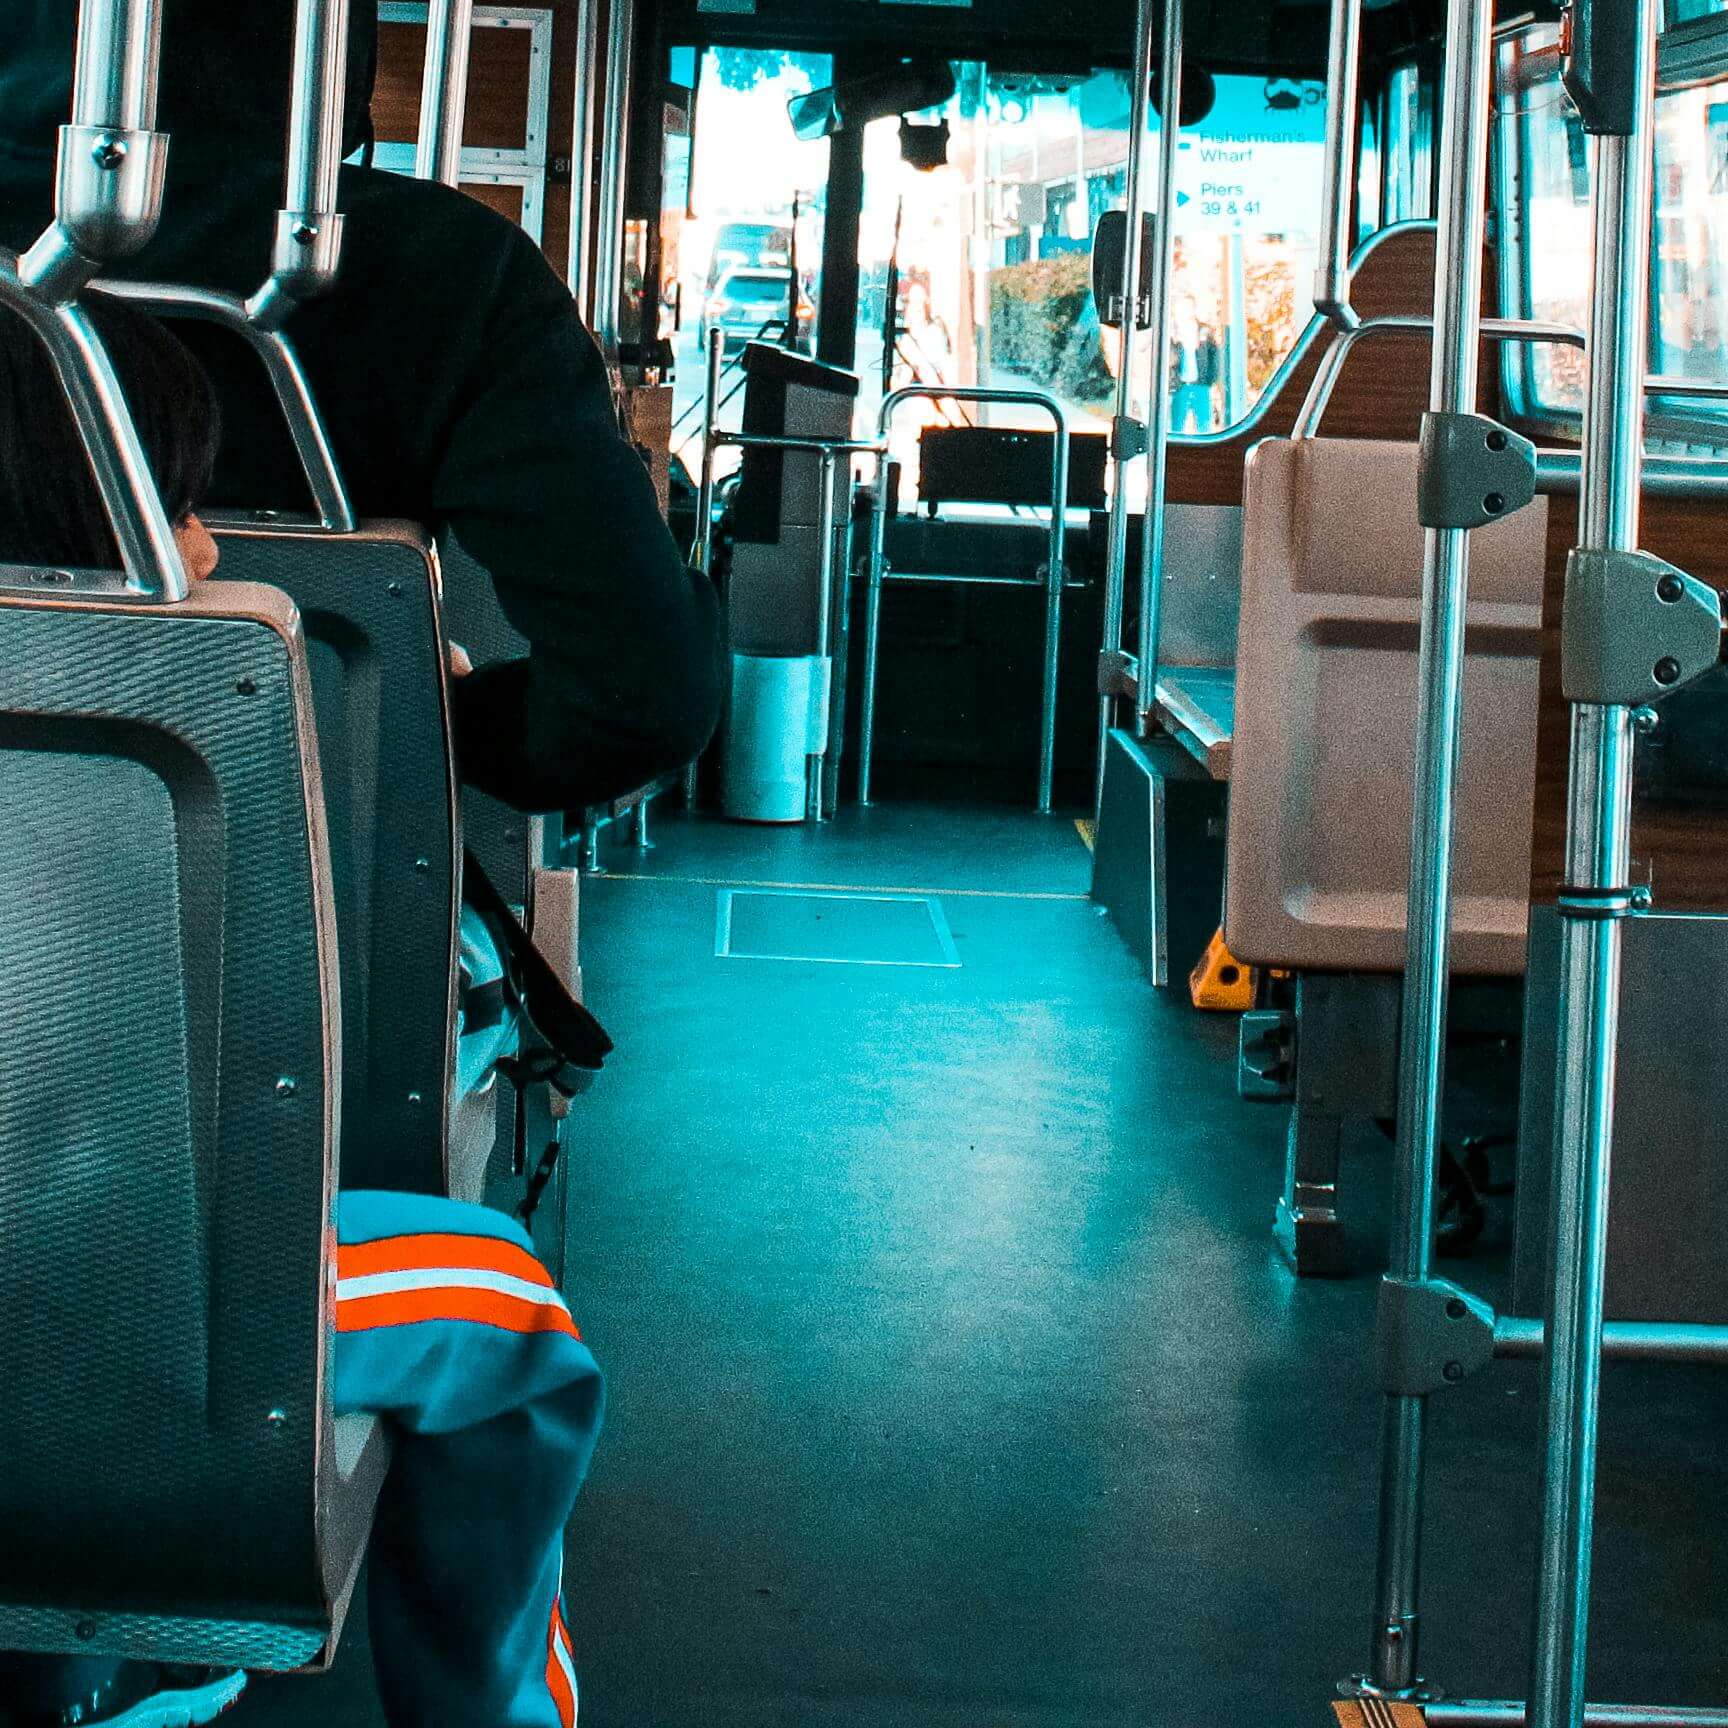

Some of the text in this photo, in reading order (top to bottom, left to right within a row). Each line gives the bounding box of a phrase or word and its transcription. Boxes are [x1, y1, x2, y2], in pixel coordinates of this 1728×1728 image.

[1199, 129, 1307, 145] Fisherman's
[1199, 148, 1254, 163] Wharf
[1201, 182, 1244, 197] Piers
[1200, 200, 1261, 216] 39 & 41
